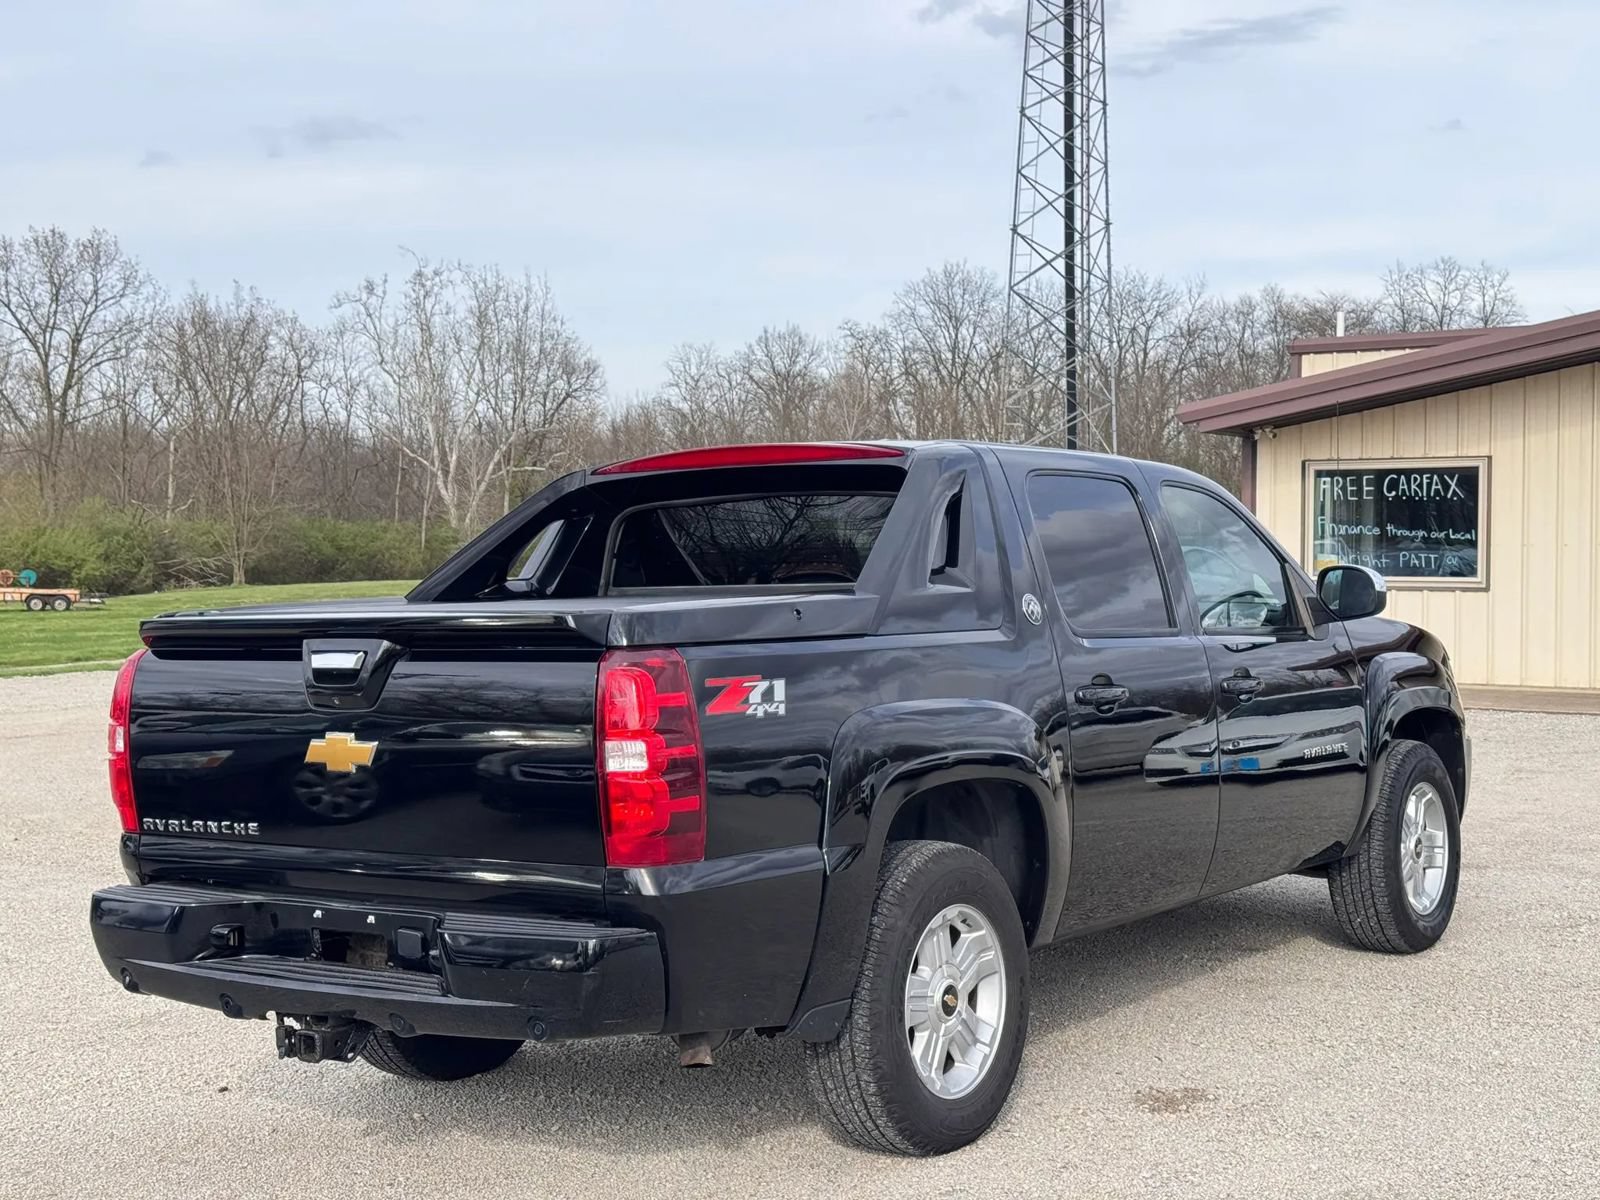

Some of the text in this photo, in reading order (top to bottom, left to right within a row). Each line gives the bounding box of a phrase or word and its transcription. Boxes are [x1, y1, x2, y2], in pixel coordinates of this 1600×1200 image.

[1319, 473, 1465, 501] FREE CARFAX
[1386, 522, 1428, 542] through
[1430, 530, 1448, 539] our
[1399, 551, 1439, 569] PATT
[705, 675, 786, 716] Z71
[142, 817, 260, 836] AVALANCHE
